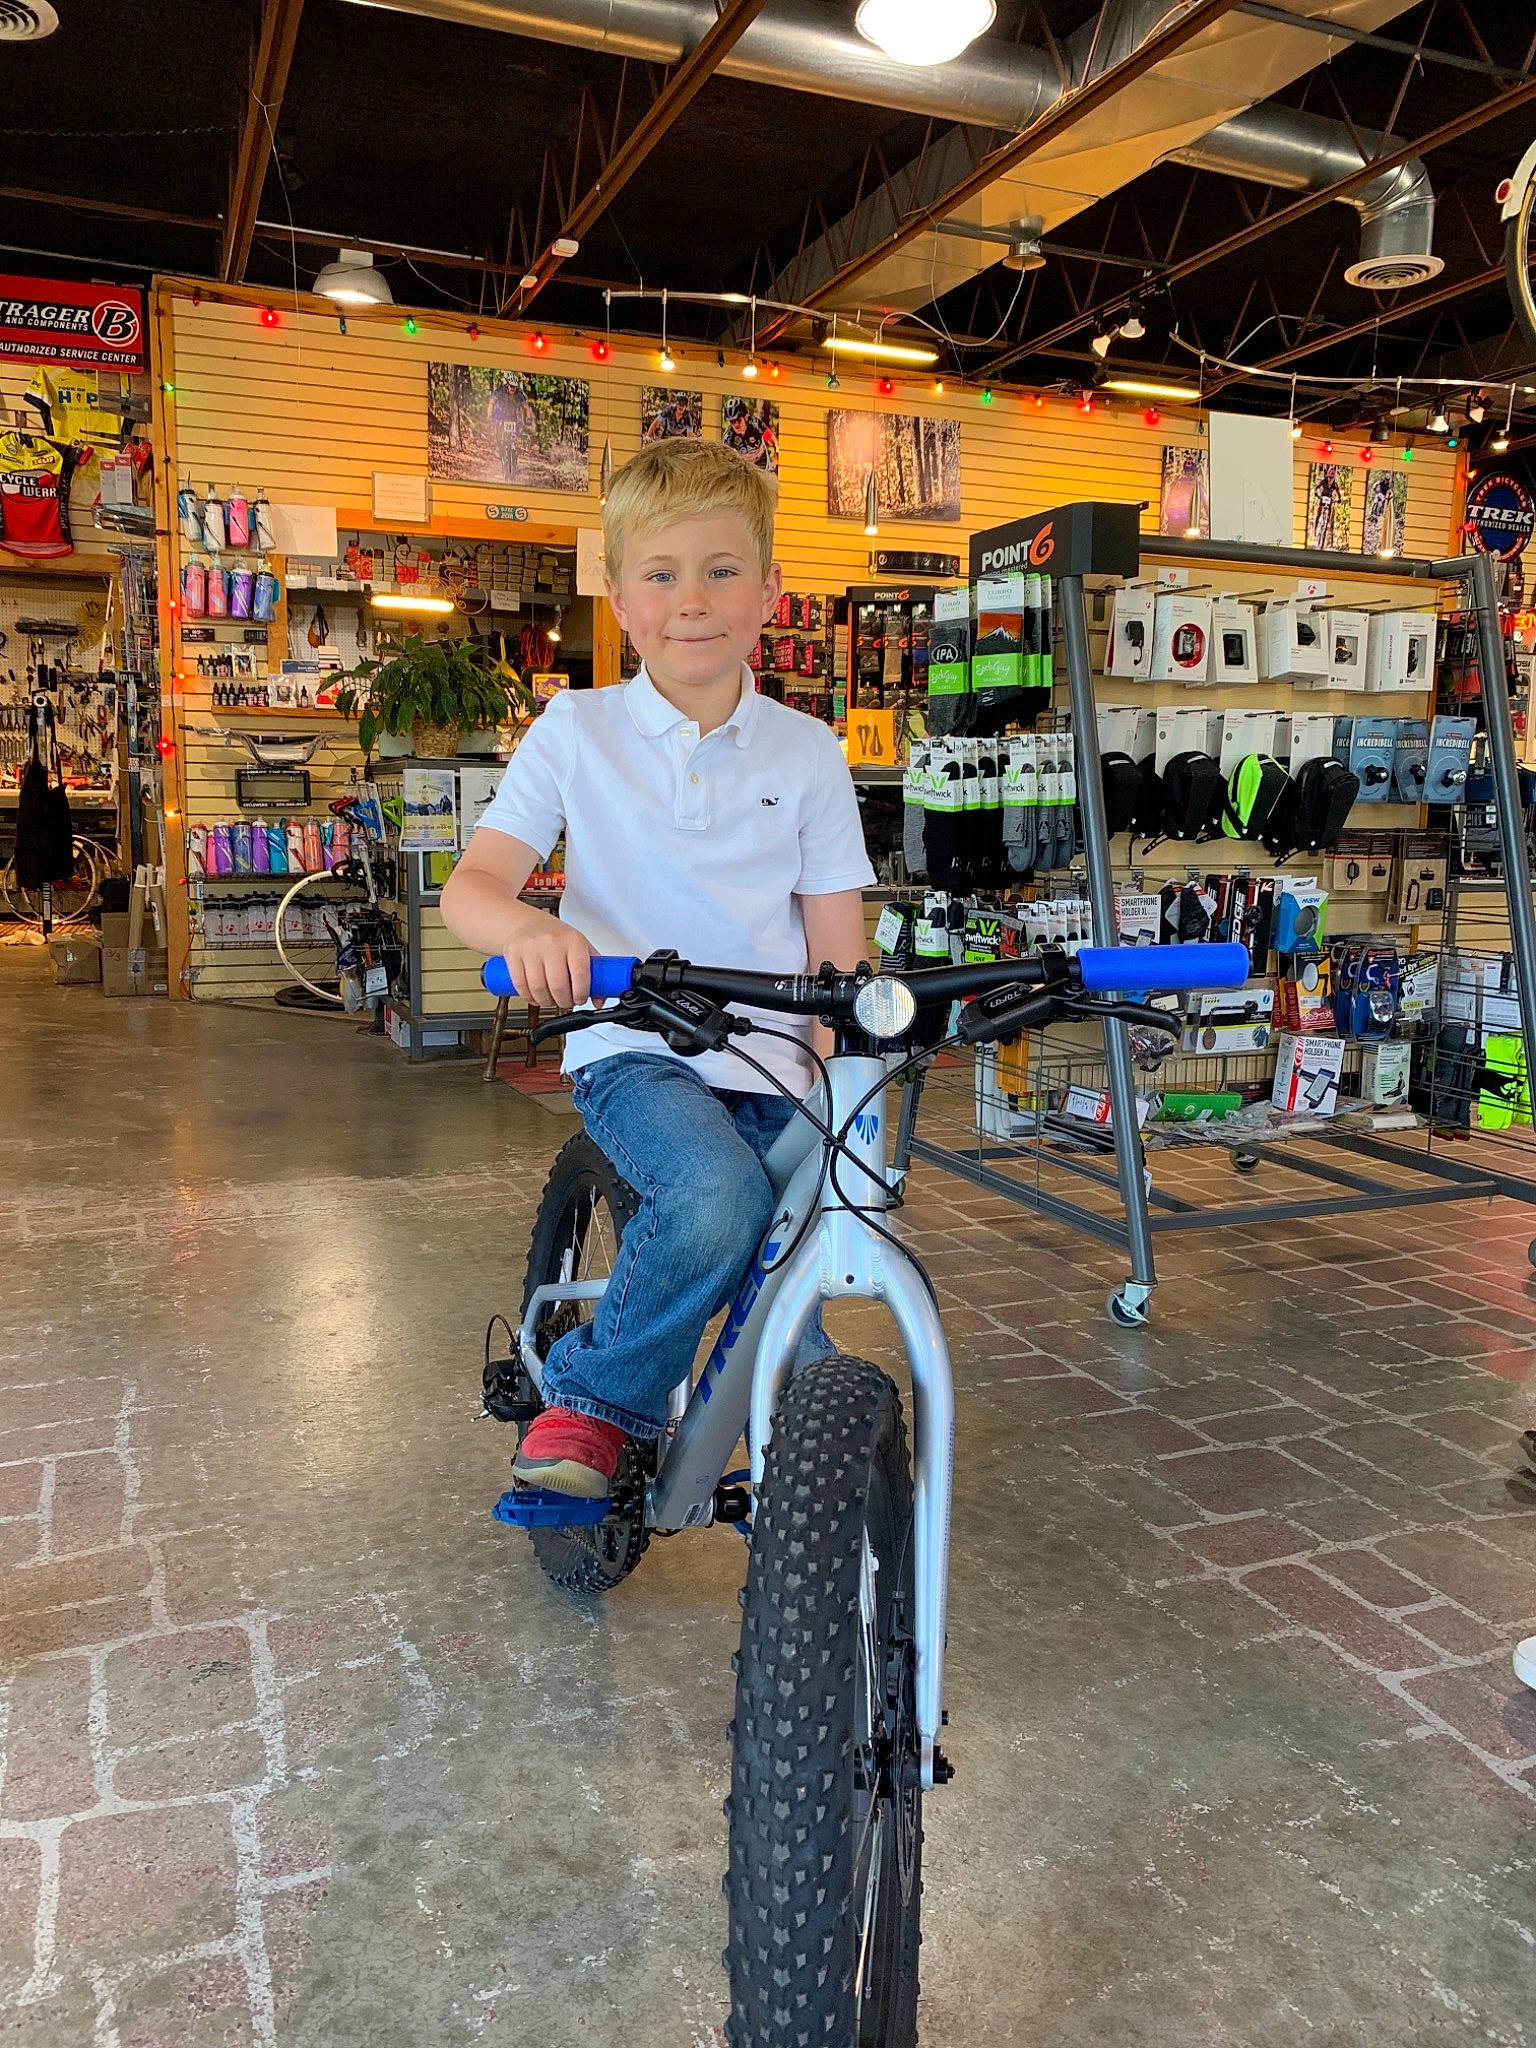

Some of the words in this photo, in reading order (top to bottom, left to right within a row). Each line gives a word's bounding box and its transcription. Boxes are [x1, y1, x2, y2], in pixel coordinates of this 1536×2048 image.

[5, 316, 24, 325] AND
[27, 318, 89, 332] COMPONENTS
[96, 305, 137, 342] B
[0, 342, 57, 356] AUTHORIZED
[59, 347, 99, 361] SERVICE
[101, 352, 137, 364] CENTER
[1467, 504, 1534, 525] TREK
[936, 648, 954, 661] IPA
[1121, 896, 1158, 907] SMARTPHONE
[1301, 897, 1321, 905] MSW
[1121, 907, 1141, 917] HOLDER
[964, 932, 1000, 946] swiftwick
[1304, 1038, 1342, 1050] SMARTPHONE
[1303, 1047, 1324, 1057] HOLDER
